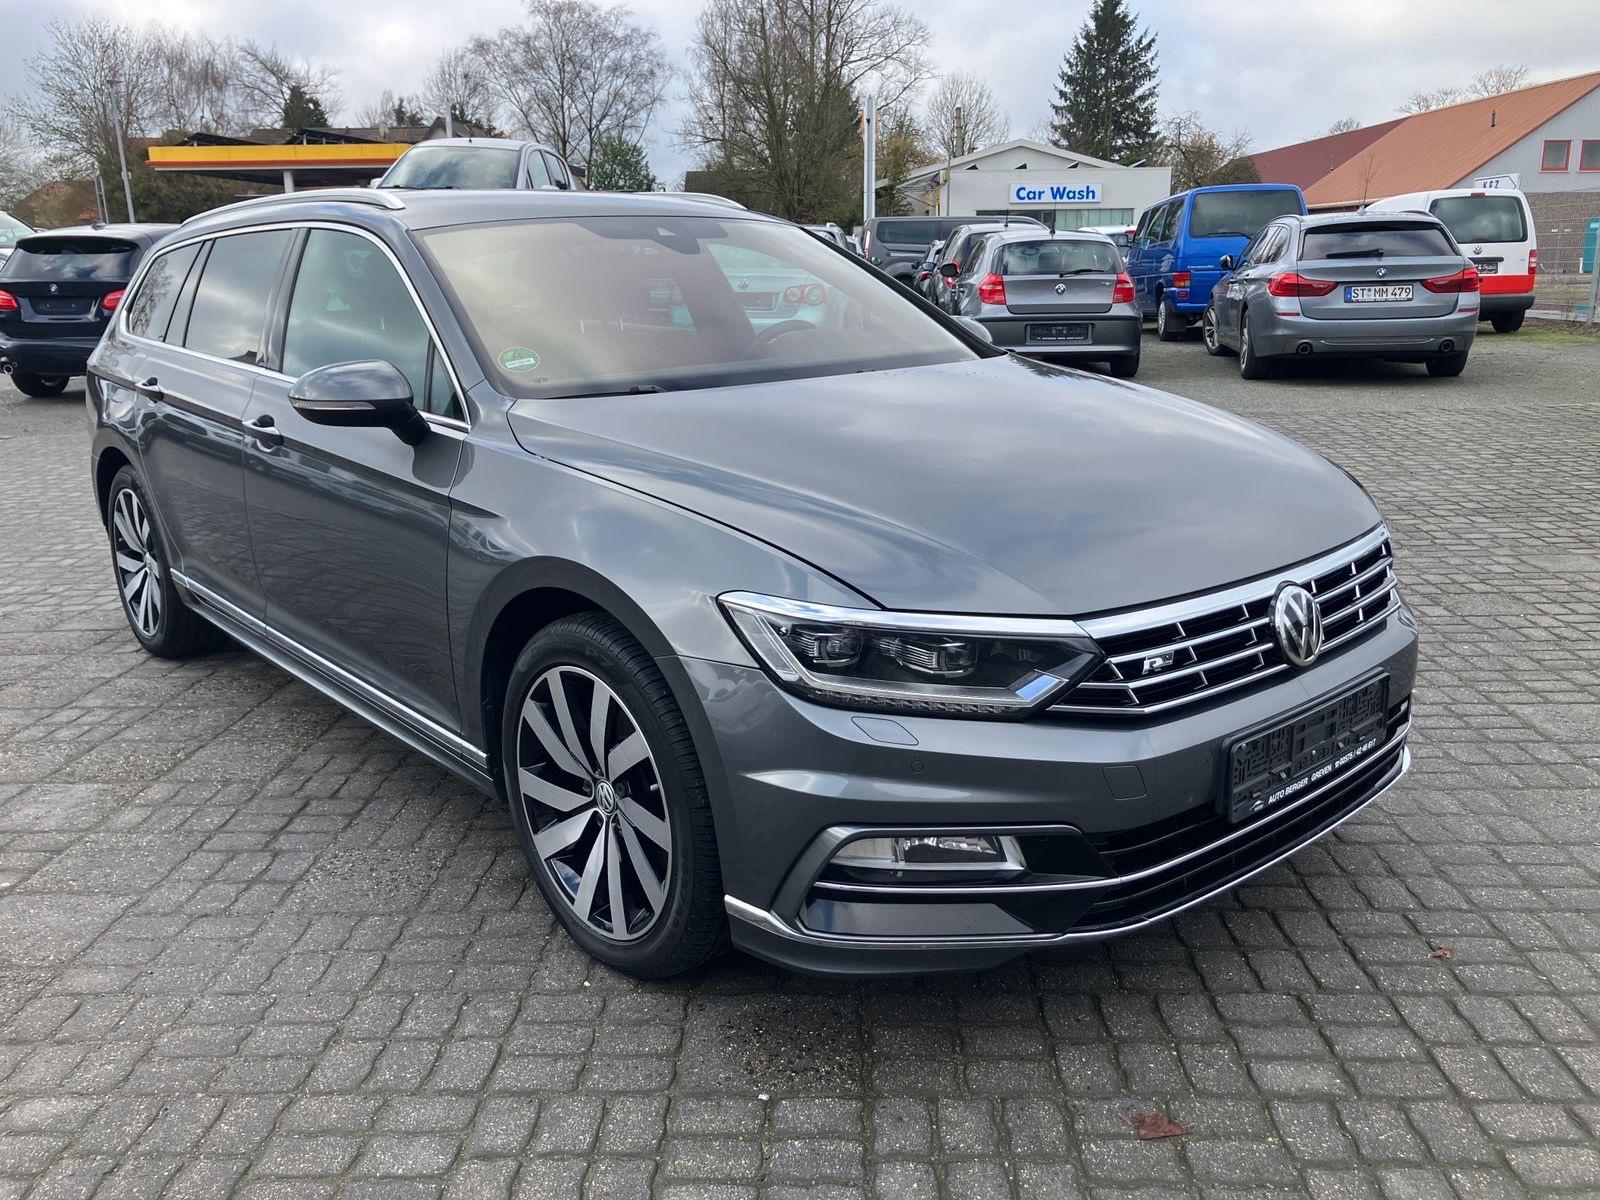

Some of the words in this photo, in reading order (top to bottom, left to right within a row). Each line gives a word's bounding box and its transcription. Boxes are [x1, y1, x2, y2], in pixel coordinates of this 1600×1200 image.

[1016, 186, 1045, 201] Car
[1050, 185, 1096, 200] Wash
[1352, 288, 1366, 299] ST
[1373, 287, 1389, 298] MM
[1391, 286, 1411, 298] 479
[1268, 789, 1285, 805] AUTO
[1285, 777, 1309, 796] BERGER
[1311, 763, 1333, 782] GREVEN
